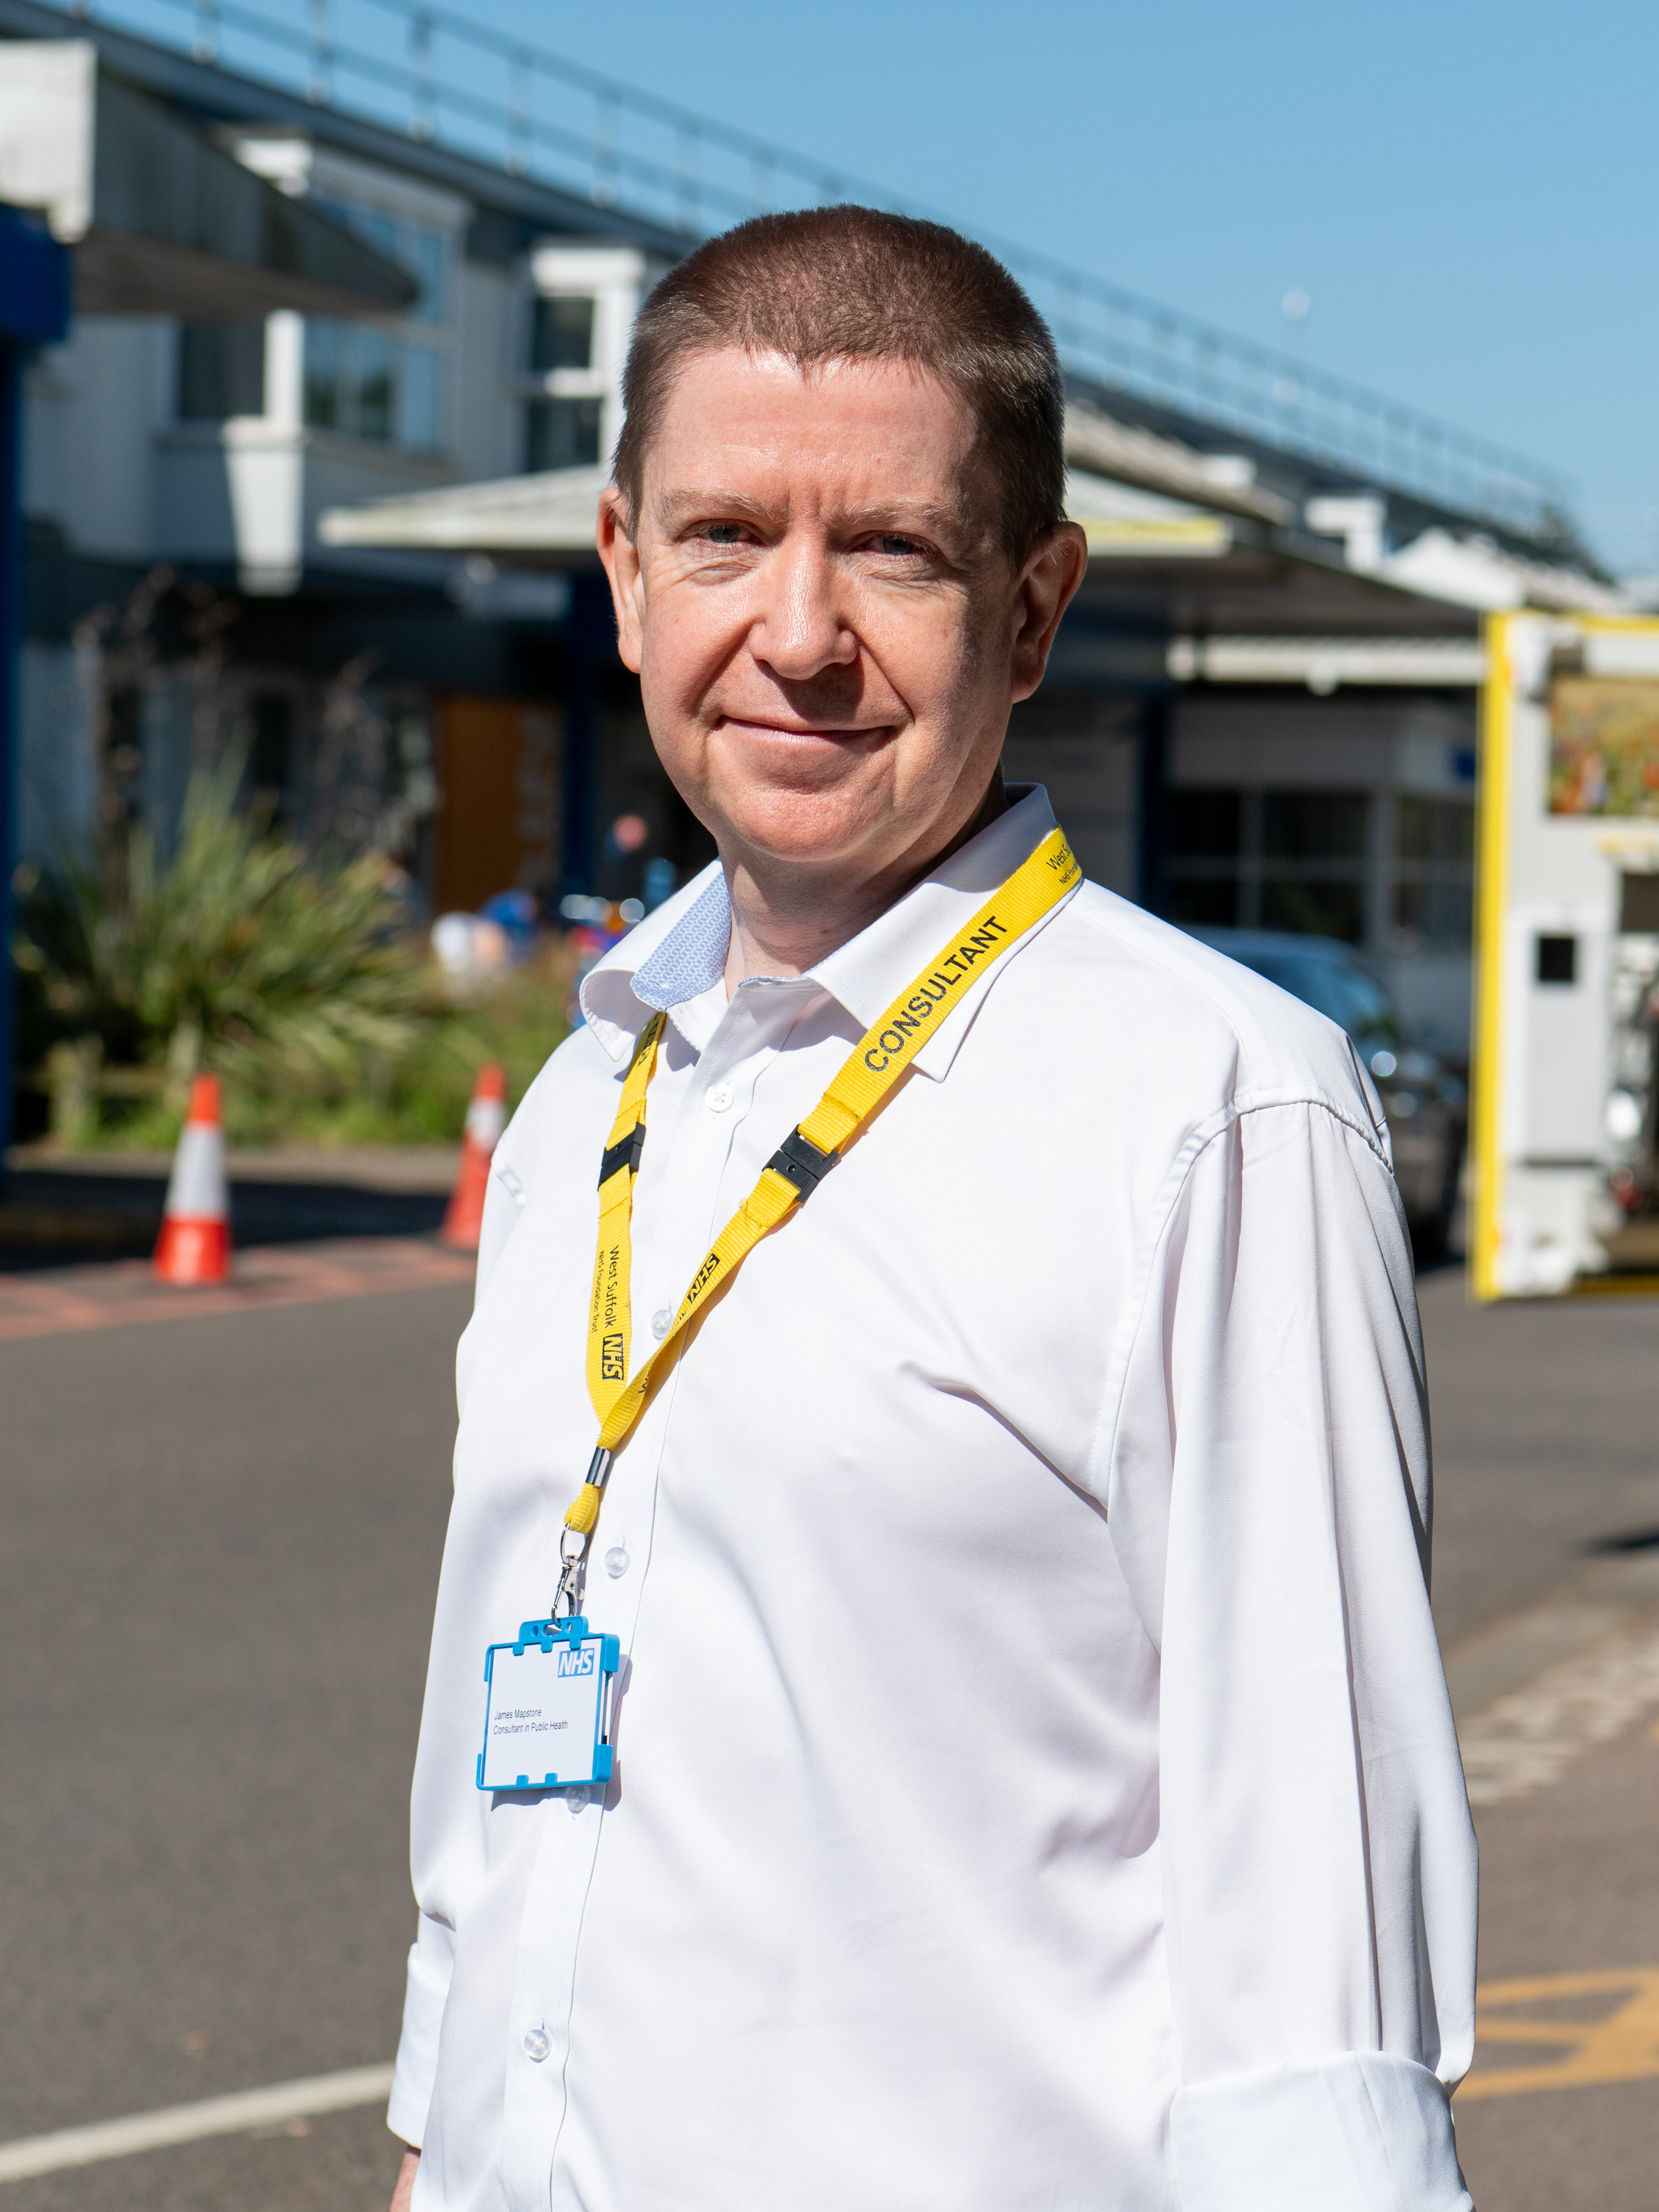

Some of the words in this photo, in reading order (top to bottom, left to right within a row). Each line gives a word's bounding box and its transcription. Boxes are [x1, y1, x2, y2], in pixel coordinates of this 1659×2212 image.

[1046, 849, 1068, 870] West
[1059, 872, 1071, 885] NHS
[864, 915, 1008, 1072] CONSULTANT
[609, 1245, 619, 1280] West
[687, 1253, 720, 1304] NHS
[593, 1268, 604, 1312] Foundation
[605, 1281, 618, 1329] Suffolk
[591, 1312, 599, 1333] Trust
[602, 1333, 624, 1380] NHS
[558, 1648, 594, 1677] NHS
[493, 1723, 524, 1734] Consultant
[524, 1722, 530, 1732] in
[531, 1721, 549, 1731] Public
[549, 1719, 568, 1731] Health
[494, 1711, 513, 1720] James
[514, 1708, 542, 1719] Mapstone
